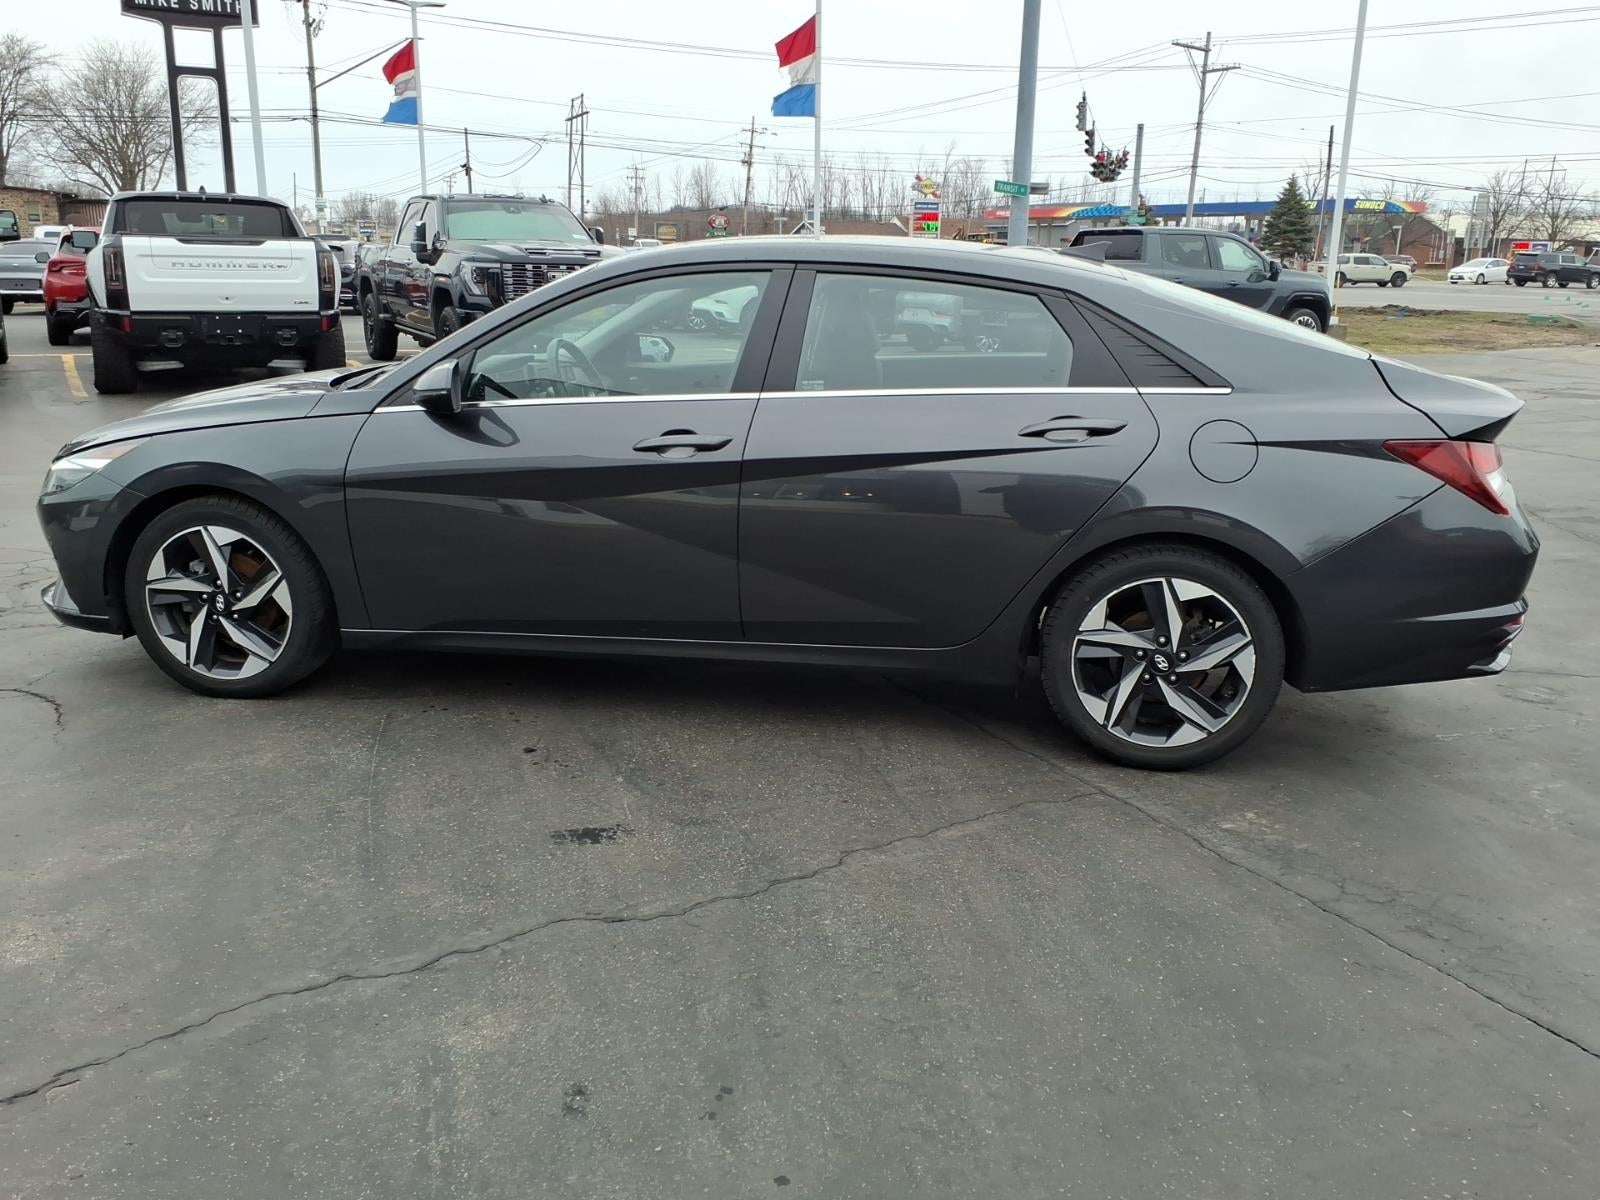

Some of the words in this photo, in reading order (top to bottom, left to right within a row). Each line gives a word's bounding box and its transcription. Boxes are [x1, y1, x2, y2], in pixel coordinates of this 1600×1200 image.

[996, 182, 1018, 193] TRANSIT
[1354, 200, 1386, 209] SUNOCO
[171, 260, 276, 269] HUMMER
